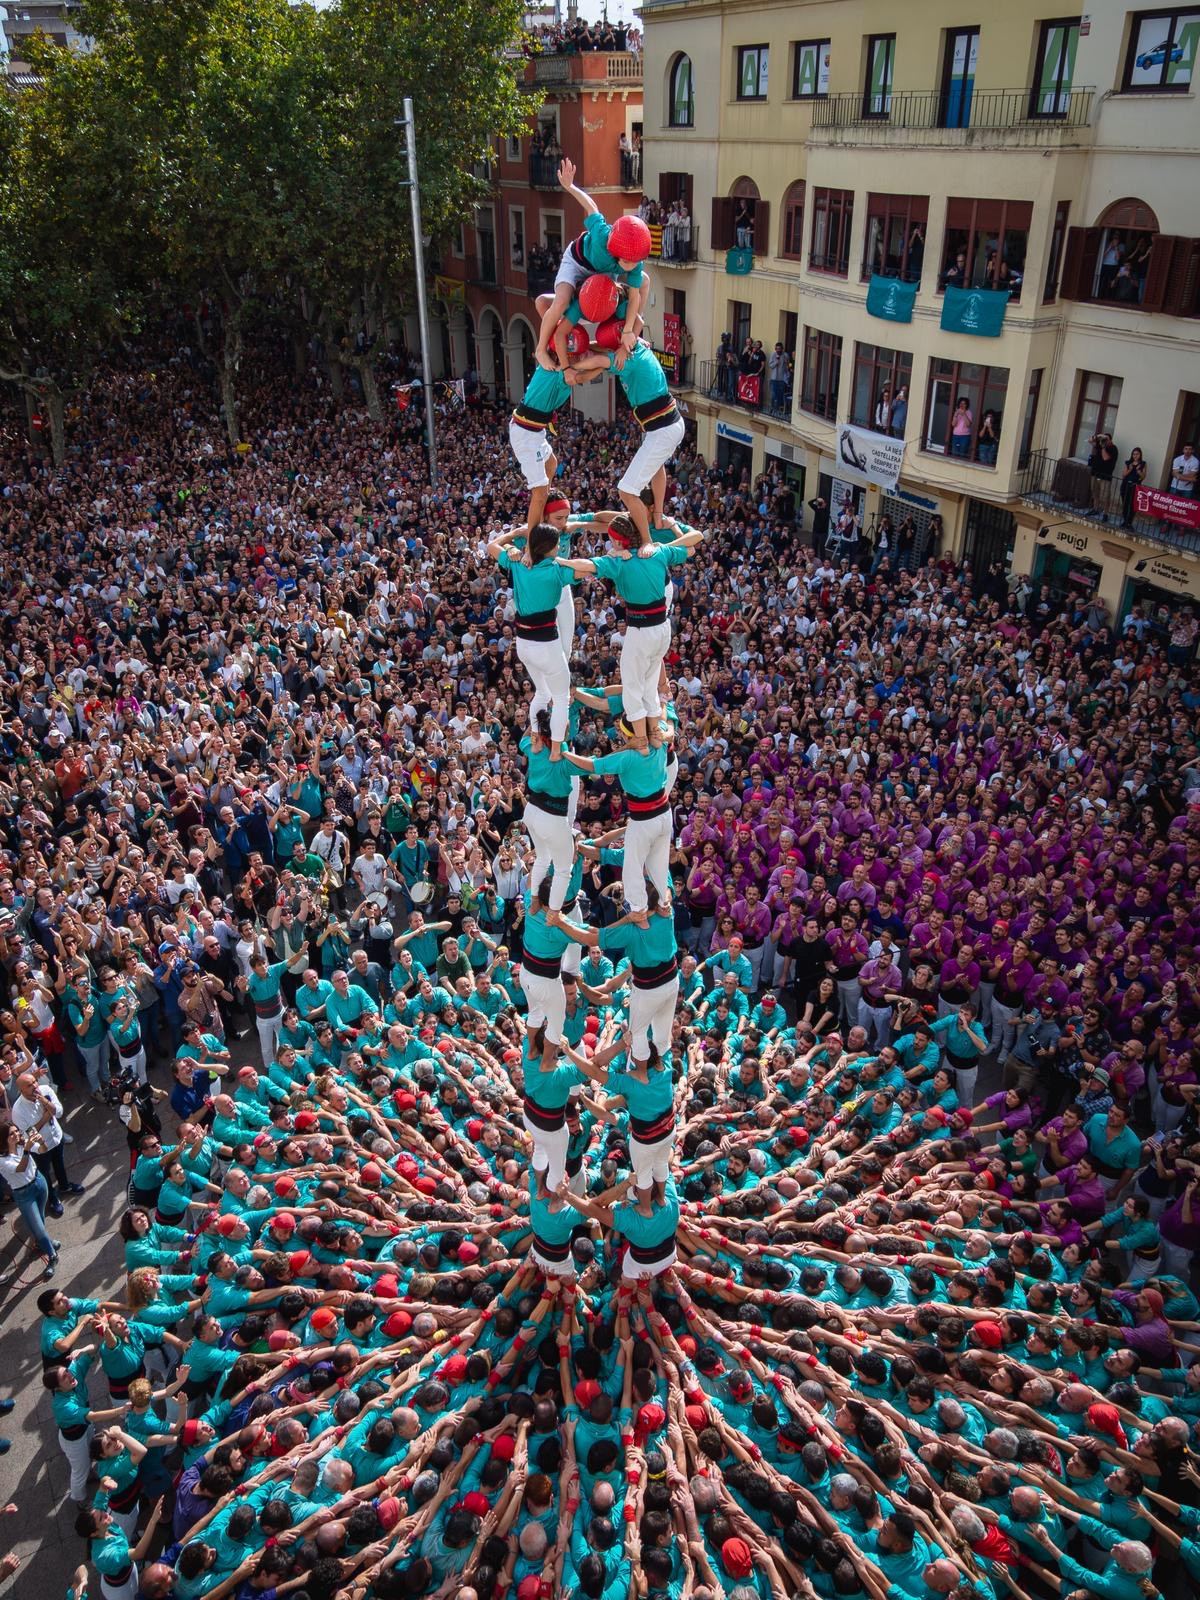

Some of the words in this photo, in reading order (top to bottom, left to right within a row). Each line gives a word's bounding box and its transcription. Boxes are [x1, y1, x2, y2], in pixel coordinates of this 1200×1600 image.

[742, 54, 757, 96] A
[799, 50, 816, 94] A
[1152, 501, 1168, 510] sense
[1172, 499, 1199, 511] casteller
[1180, 568, 1188, 576] de
